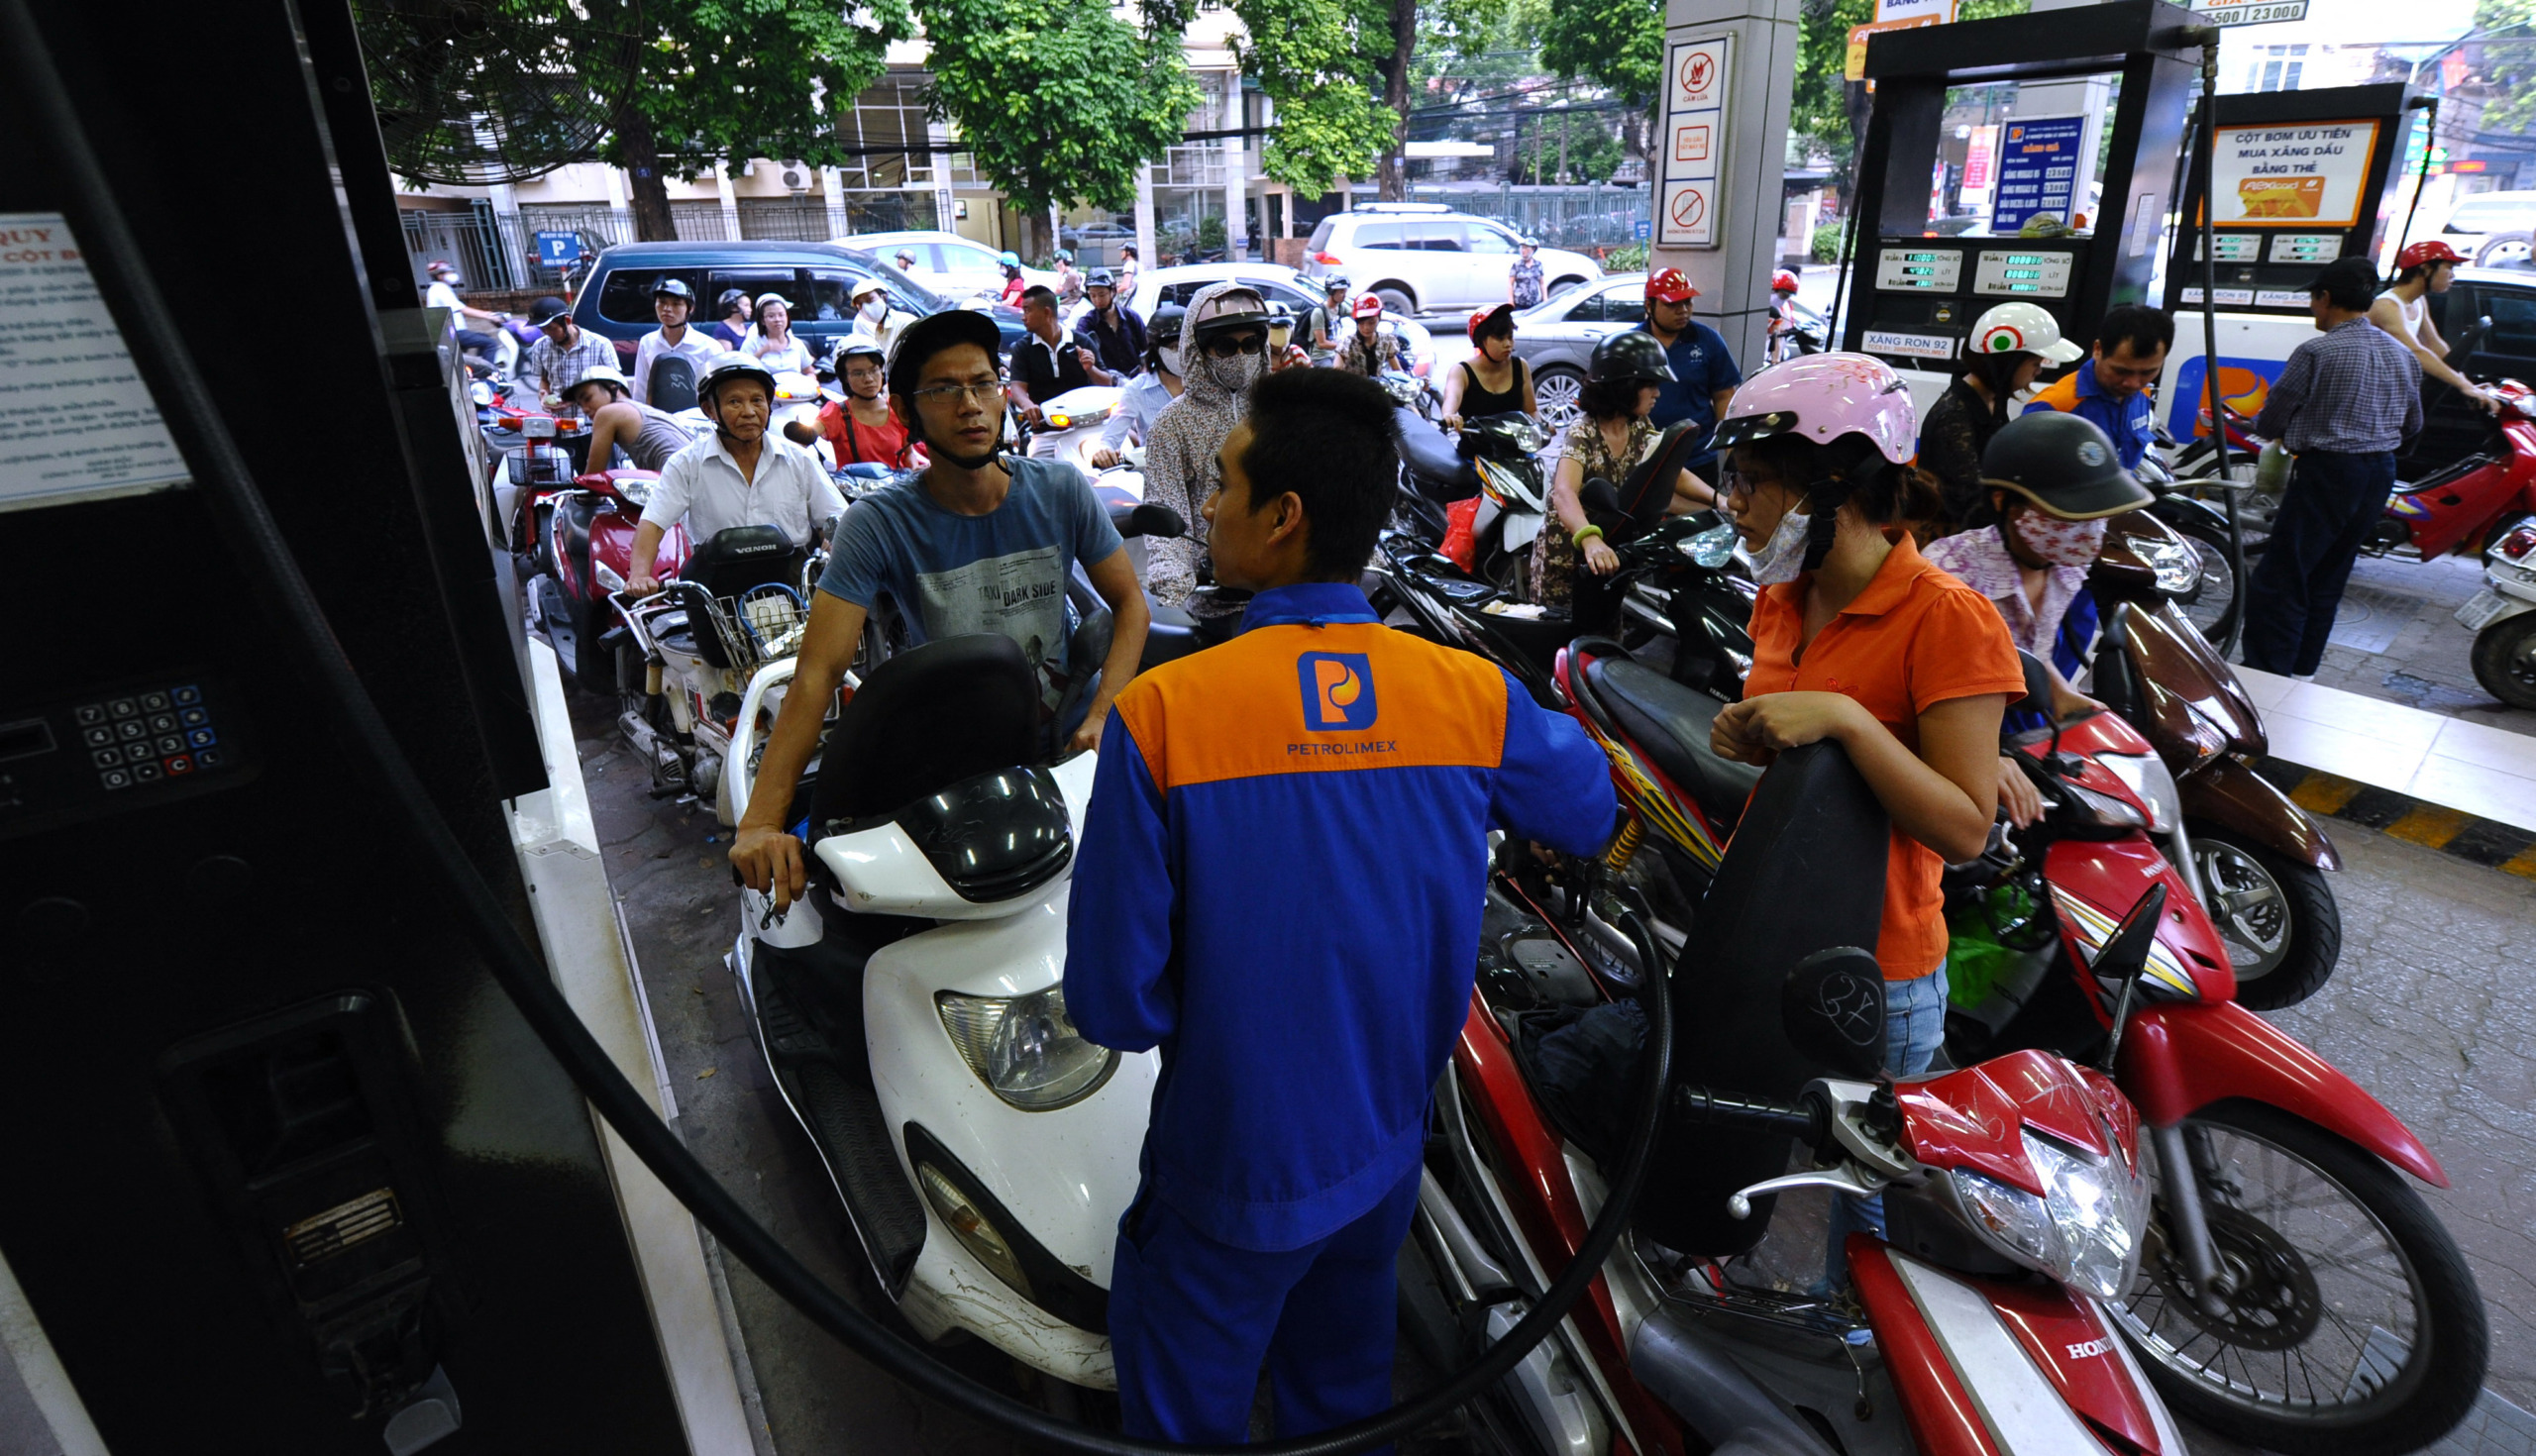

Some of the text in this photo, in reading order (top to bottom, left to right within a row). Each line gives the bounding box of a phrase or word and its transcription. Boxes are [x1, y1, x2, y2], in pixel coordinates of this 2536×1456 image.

[2252, 5, 2299, 21] 23000
[2236, 132, 2261, 145] CỘT
[2265, 131, 2293, 143] BƠM
[2238, 149, 2267, 158] MUA
[2272, 147, 2310, 157] XĂNG
[551, 240, 566, 257] P
[1868, 334, 1949, 350] XĂNG RON 92
[735, 544, 777, 554] HONDA
[1004, 583, 1029, 607] DARK
[1031, 579, 1057, 599] SIDE
[85, 709, 95, 720] 7
[1287, 740, 1398, 756] PETROLIMEX
[171, 760, 187, 772] C
